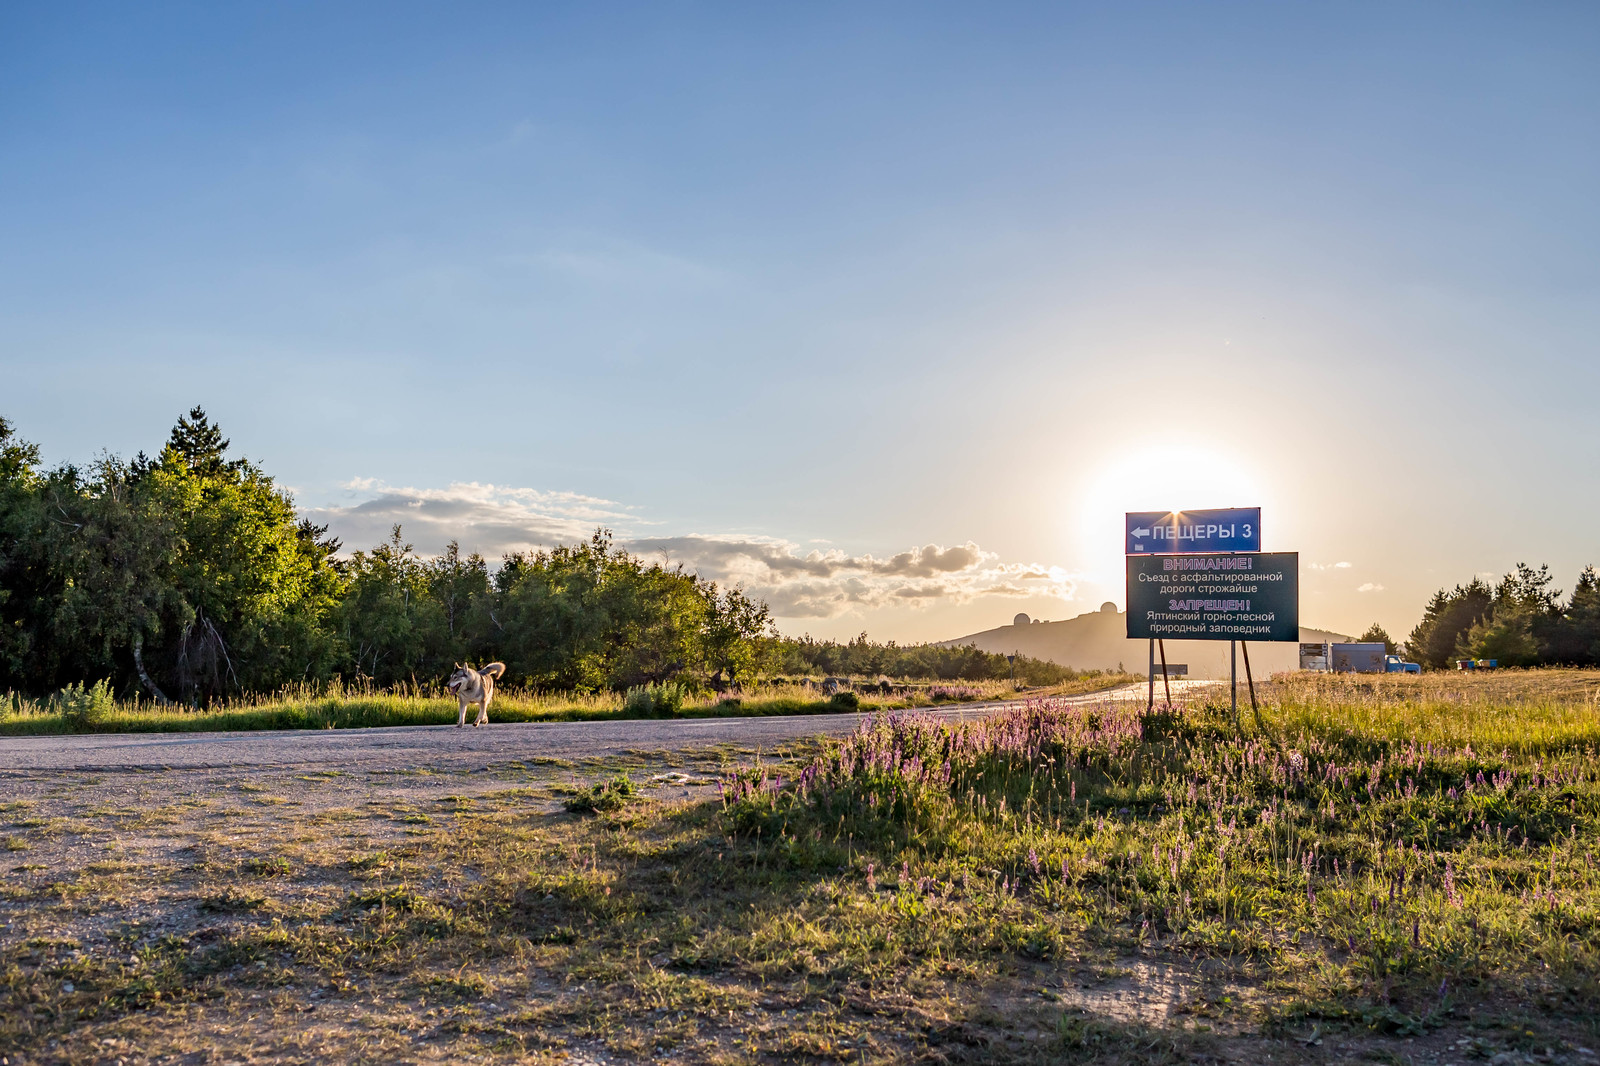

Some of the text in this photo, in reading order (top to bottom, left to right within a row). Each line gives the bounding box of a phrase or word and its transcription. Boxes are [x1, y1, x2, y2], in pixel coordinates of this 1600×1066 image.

[1153, 524, 1252, 541] ПЕЩЕРЫ 3
[1163, 558, 1252, 570] ВНИМАНИЕ!
[1138, 573, 1169, 582] Съезд
[1181, 572, 1283, 583] асфальтированной
[1160, 584, 1258, 594] дороги строжайше
[1169, 600, 1250, 612] ЗАПРЕЩЕН!
[1147, 611, 1274, 622] Ялтинский горно-лесной
[1150, 622, 1270, 634] природный заповедник
